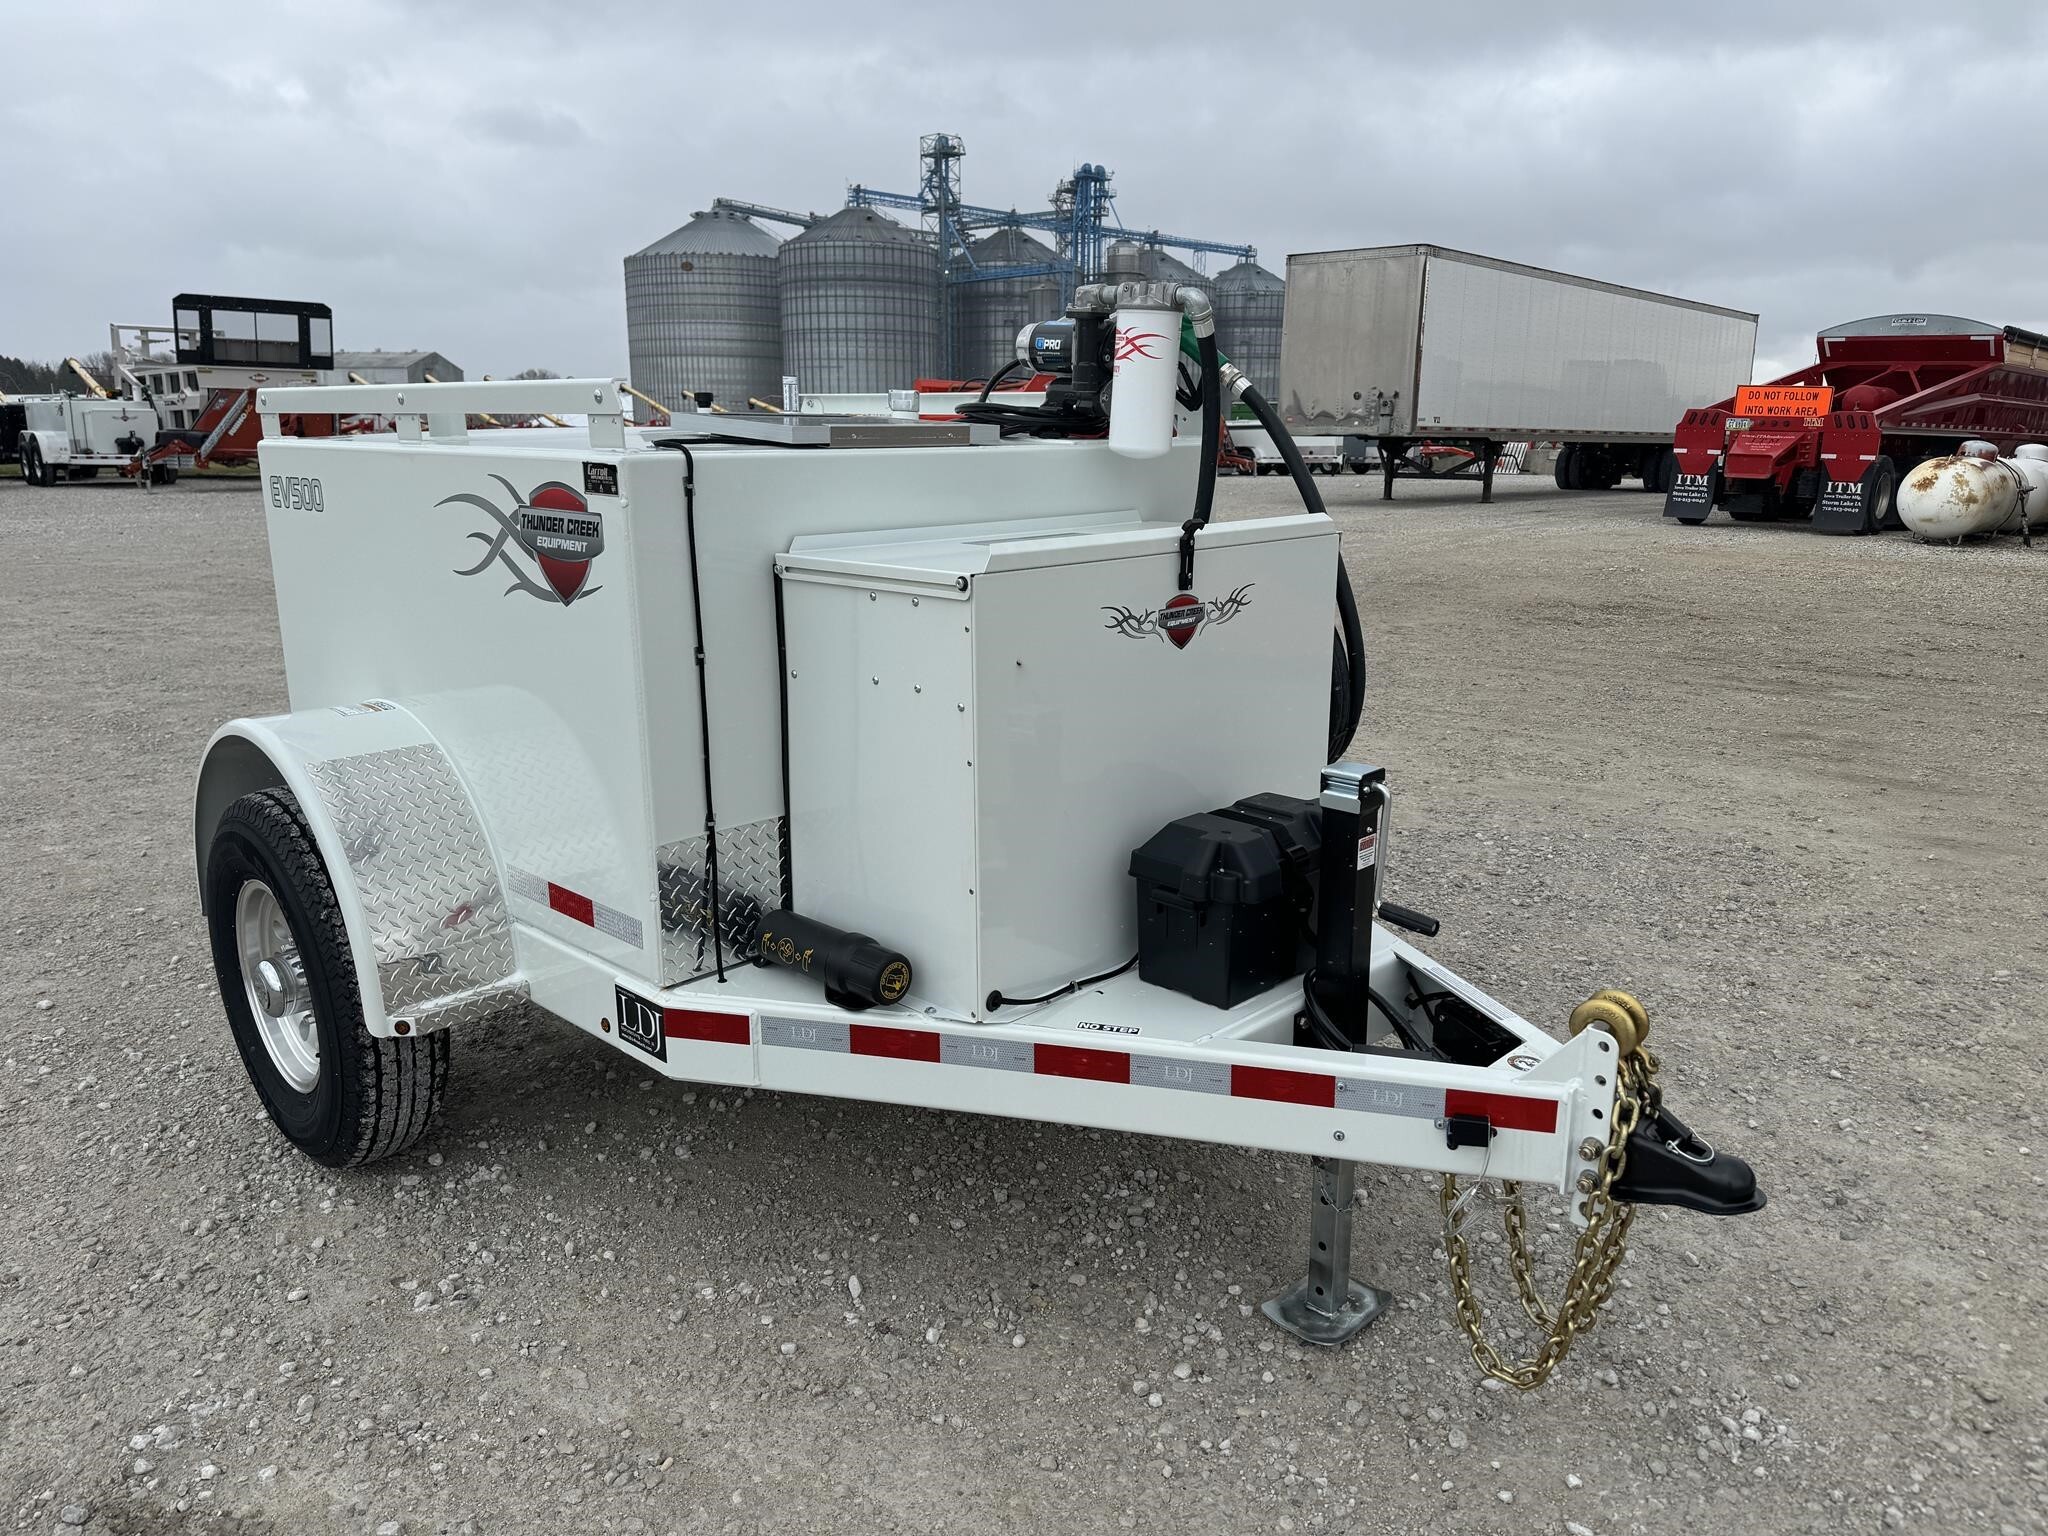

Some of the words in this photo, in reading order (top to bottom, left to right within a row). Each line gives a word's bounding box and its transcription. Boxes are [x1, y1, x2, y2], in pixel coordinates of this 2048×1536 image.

[1748, 391, 1760, 400] DO
[1763, 391, 1781, 400] NOT
[1783, 392, 1819, 401] FOLLOW
[1744, 405, 1764, 415] INTO
[1767, 406, 1791, 415] WORK
[1794, 406, 1818, 416] AREA
[1676, 474, 1709, 486] ITM
[1826, 481, 1863, 494] ITM
[270, 475, 325, 513] EV500
[521, 513, 565, 534] THUNDER
[566, 518, 600, 538] CREEK
[536, 535, 588, 552] EQUIPMENT
[1160, 610, 1185, 620] THUNDER
[1187, 606, 1204, 616] CREEK
[1167, 616, 1196, 626] EQUIPMENT
[619, 993, 662, 1053] LDJ
[1078, 1022, 1100, 1030] NO
[1102, 1025, 1138, 1034] STEP
[791, 1026, 816, 1041] LDJ
[972, 1045, 999, 1062] LDJ
[1164, 1066, 1194, 1083] LDJ
[1372, 1089, 1404, 1109] LDJ
